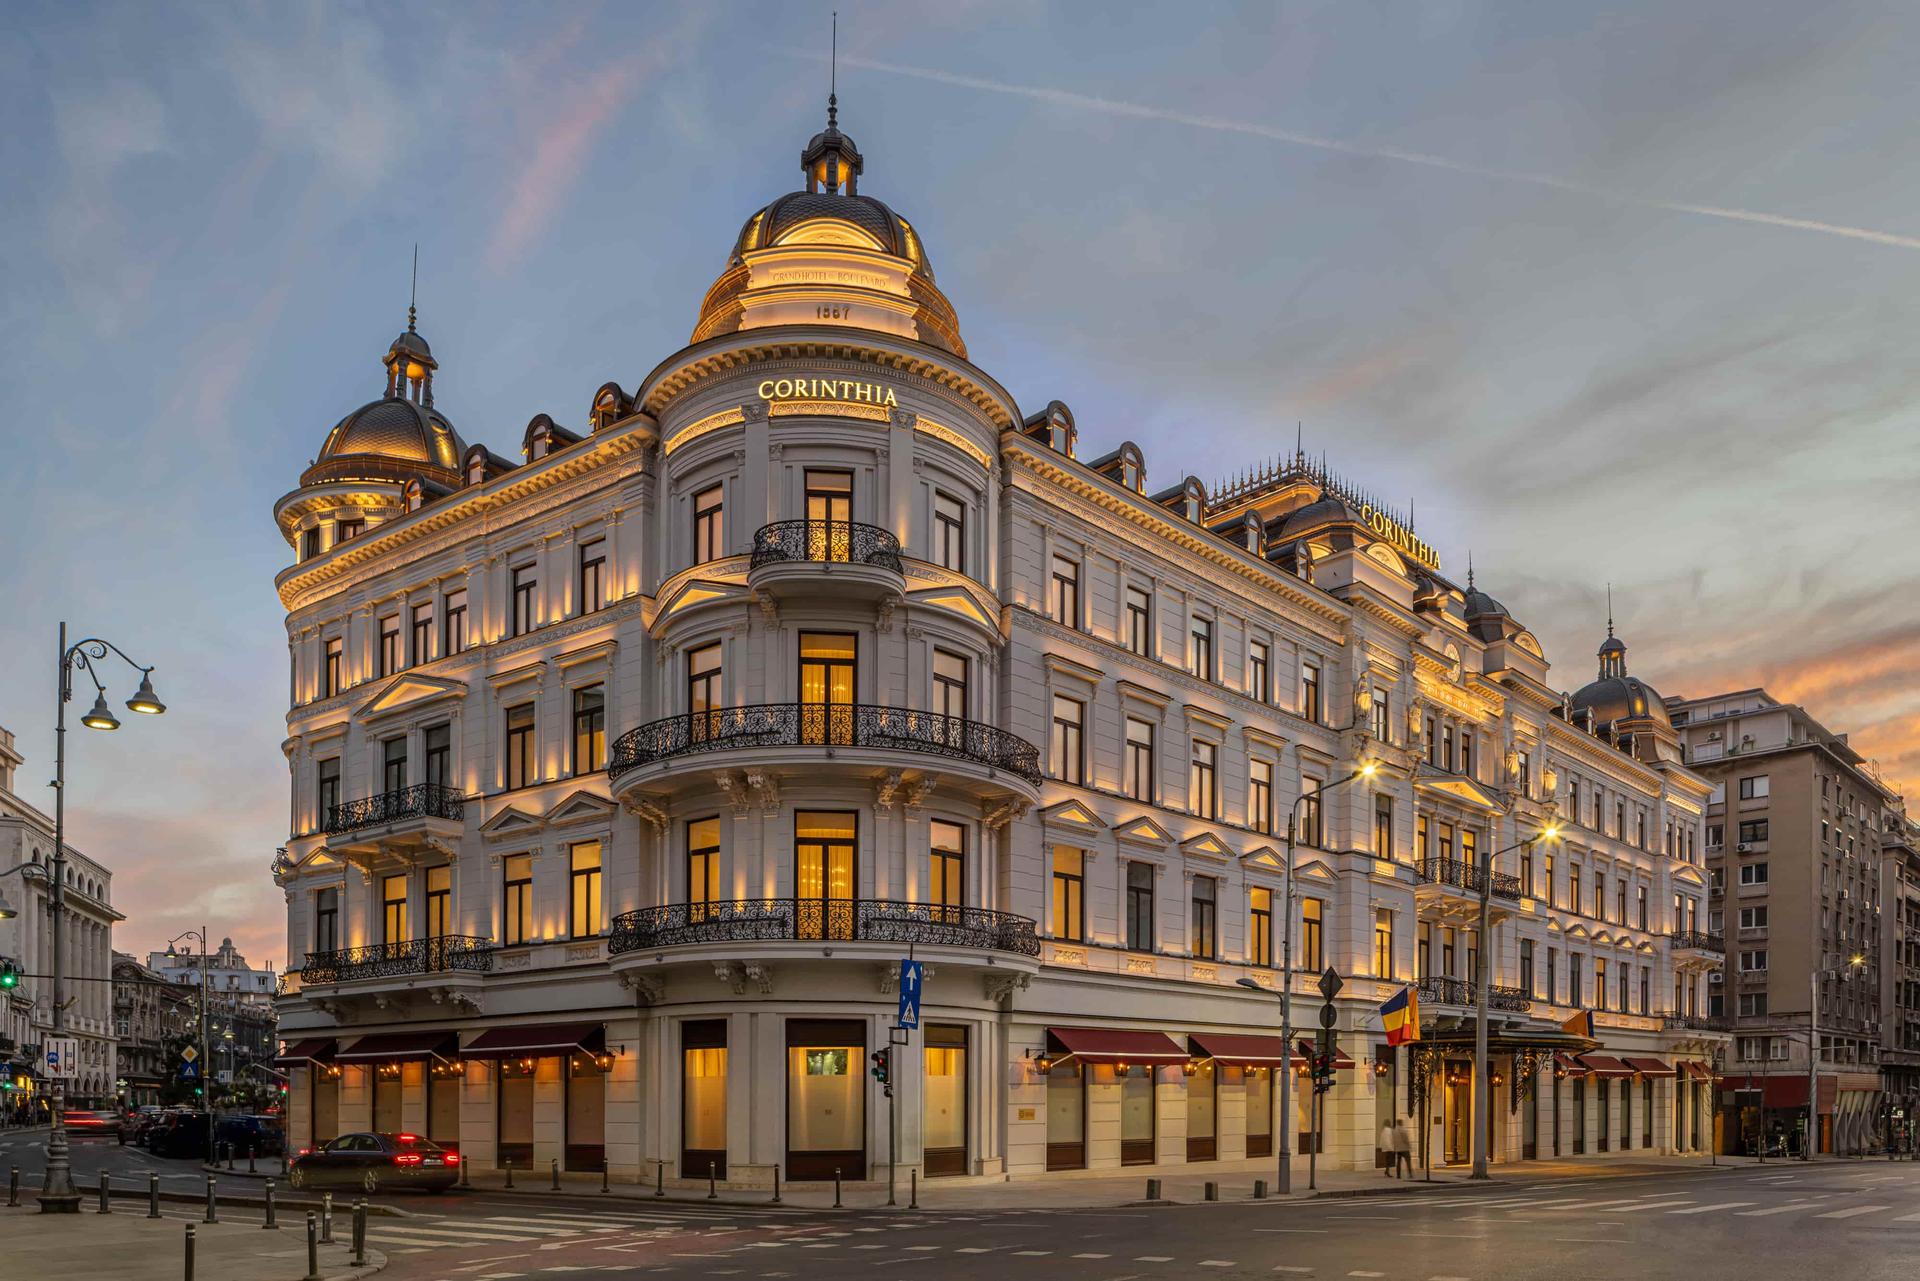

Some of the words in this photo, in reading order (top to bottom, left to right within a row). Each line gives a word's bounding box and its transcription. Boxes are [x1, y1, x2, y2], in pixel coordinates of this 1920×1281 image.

[772, 271, 801, 281] GRAND
[802, 271, 827, 281] HOTEL
[837, 271, 886, 288] BOULEVARD
[758, 379, 898, 407] CORINTHIA
[1362, 504, 1441, 570] CORINTHIA
